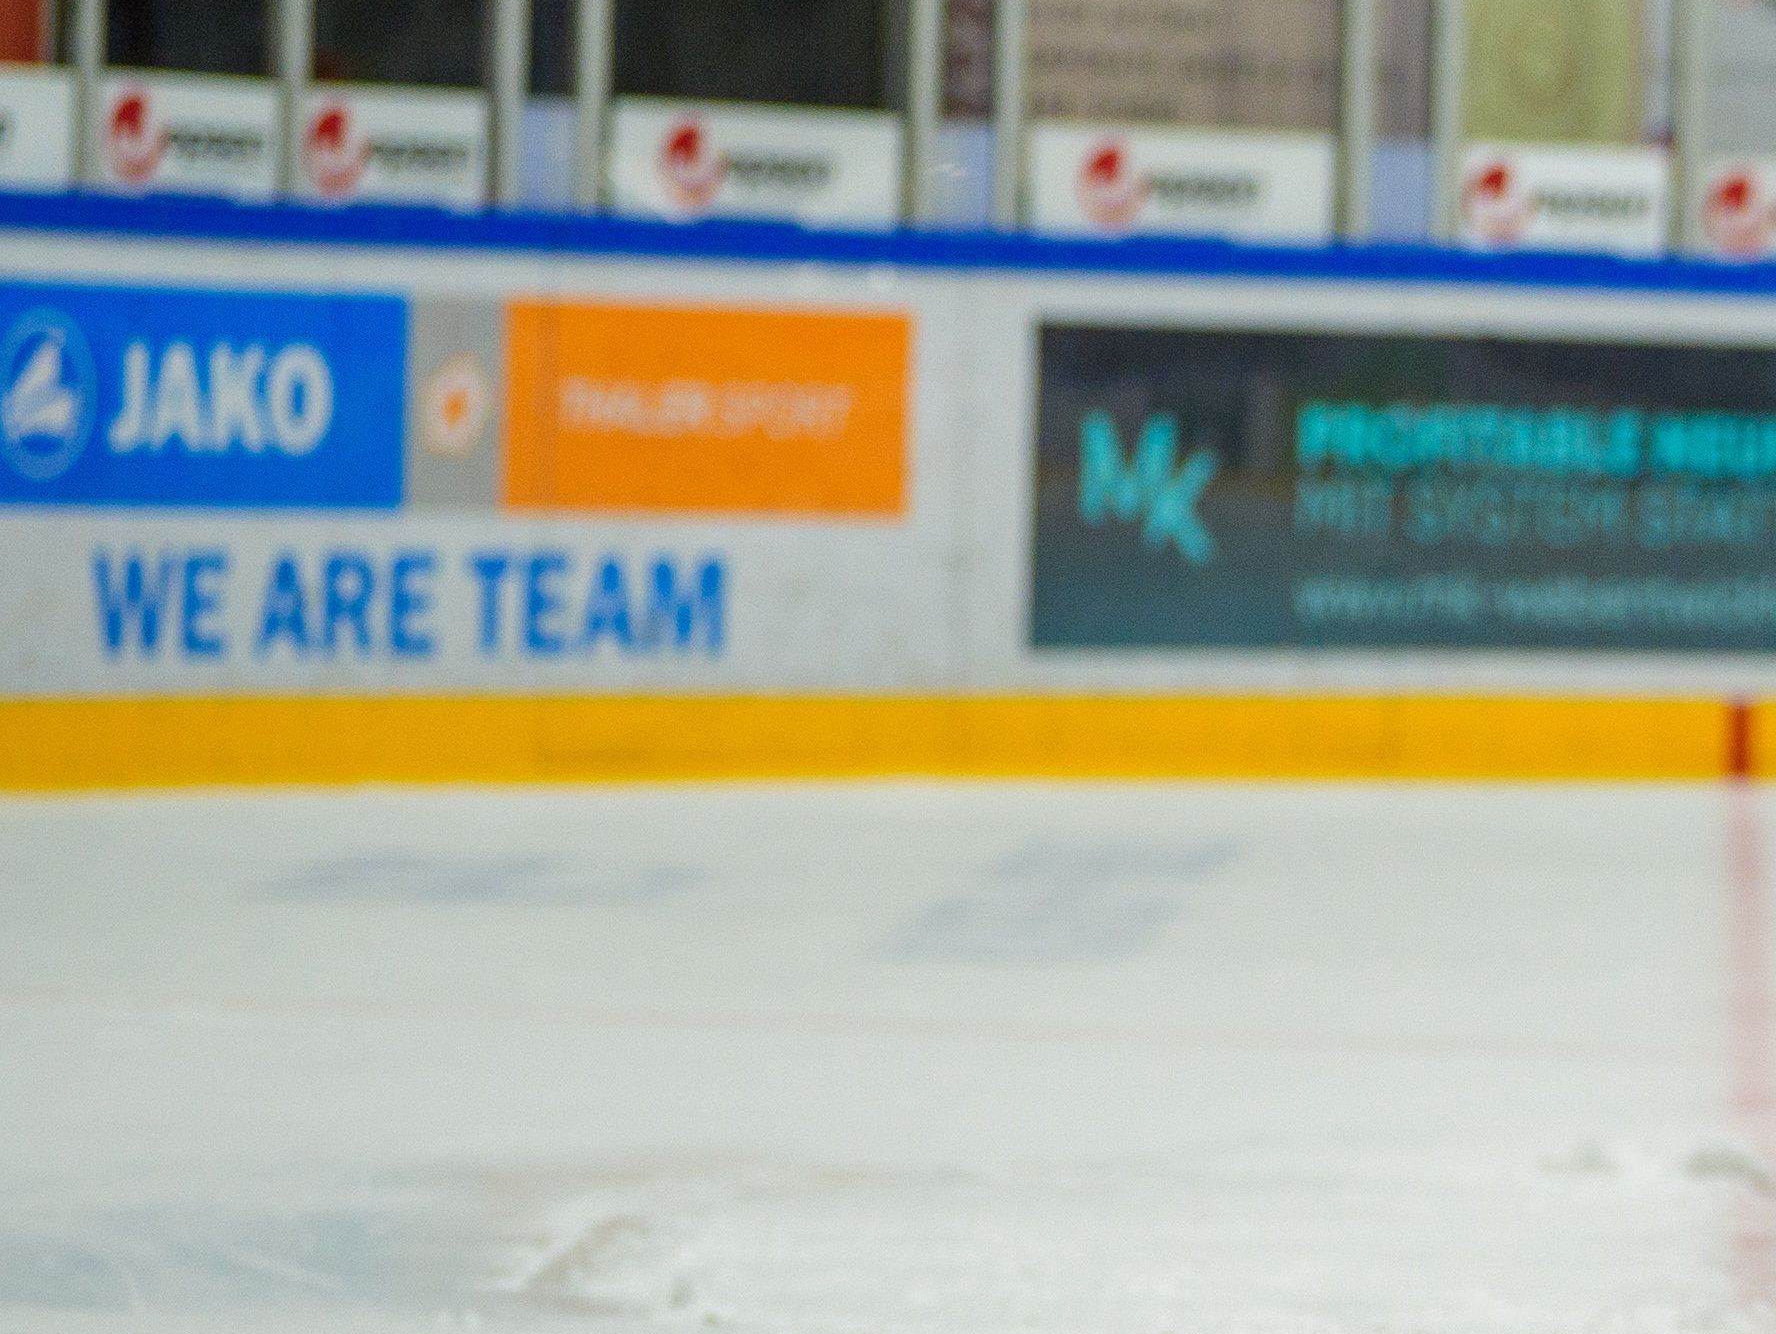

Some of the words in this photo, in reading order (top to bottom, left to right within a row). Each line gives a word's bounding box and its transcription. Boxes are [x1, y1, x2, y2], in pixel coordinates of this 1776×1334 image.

[107, 341, 335, 455] JAKO
[92, 547, 232, 659] WE
[255, 547, 438, 659] ARE
[466, 547, 729, 660] TEAM
